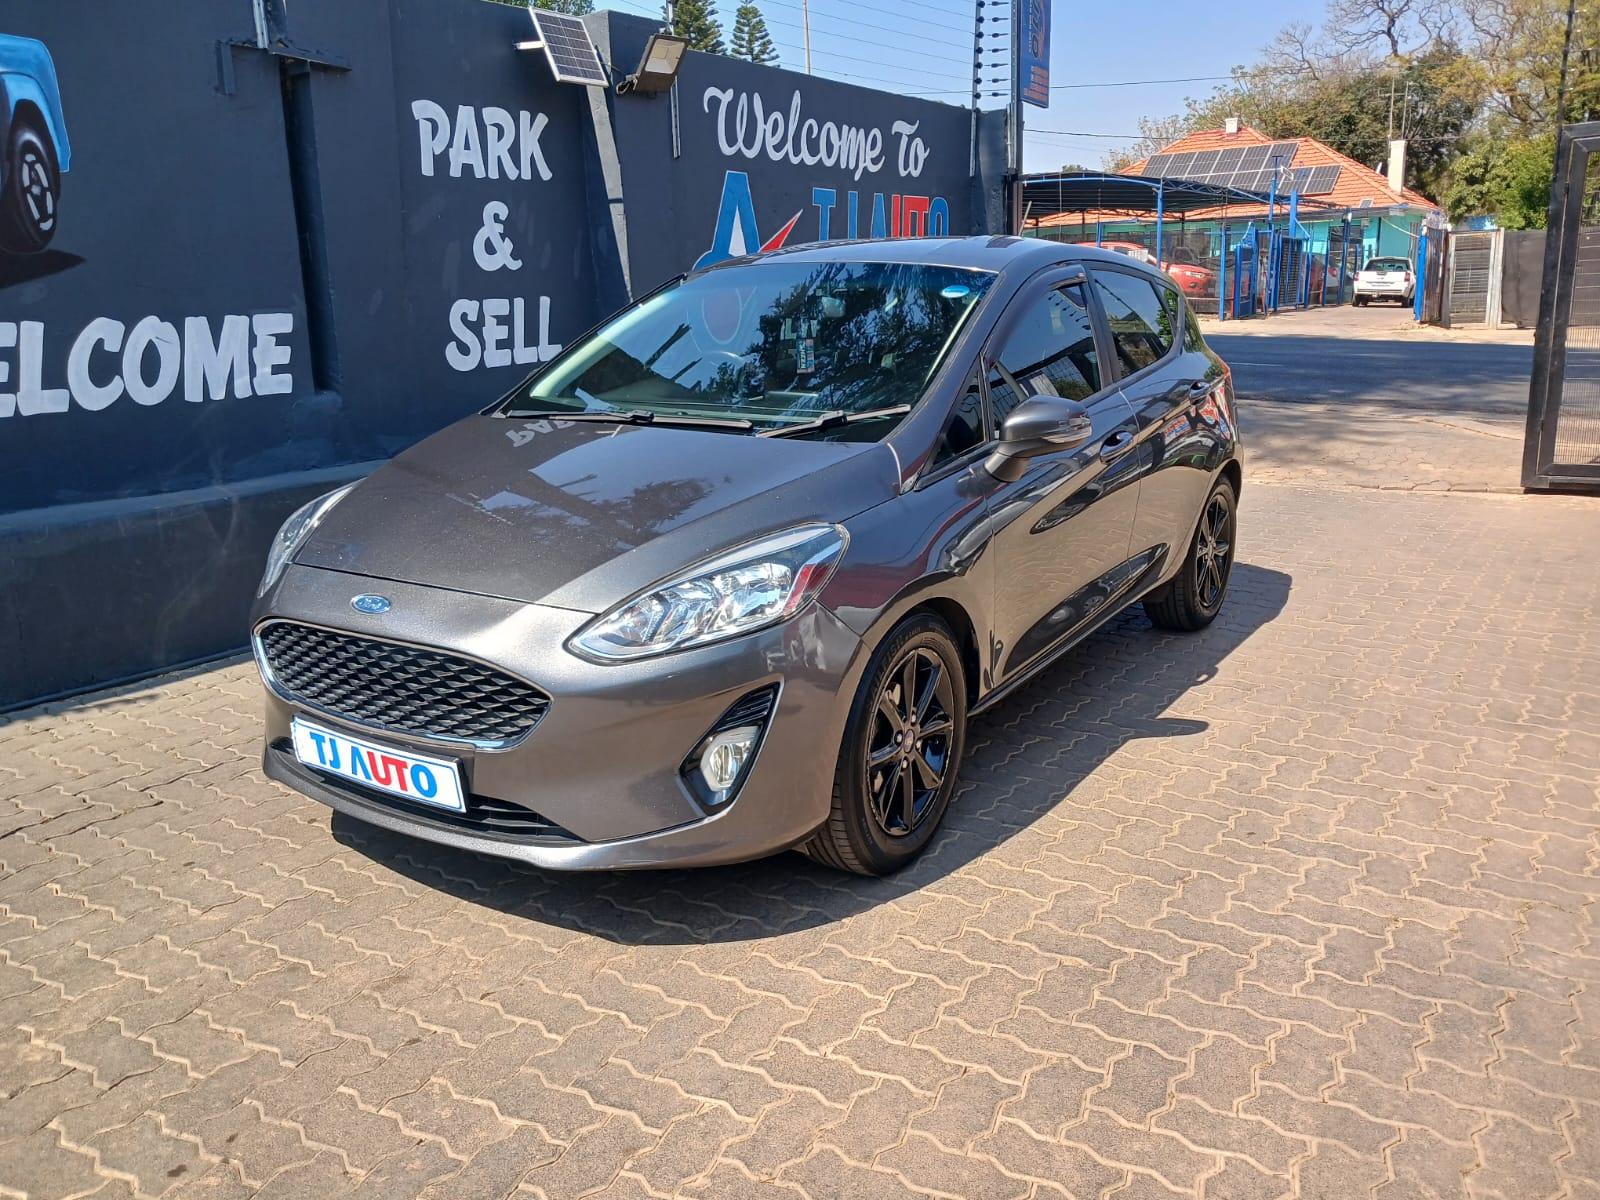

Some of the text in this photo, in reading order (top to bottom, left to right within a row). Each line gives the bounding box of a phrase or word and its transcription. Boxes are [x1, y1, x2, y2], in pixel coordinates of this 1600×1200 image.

[411, 99, 552, 181] PARK
[703, 86, 930, 182] Welcome To
[472, 200, 523, 272] &
[445, 295, 563, 372] SELL
[309, 730, 438, 799] TJ AUTO
